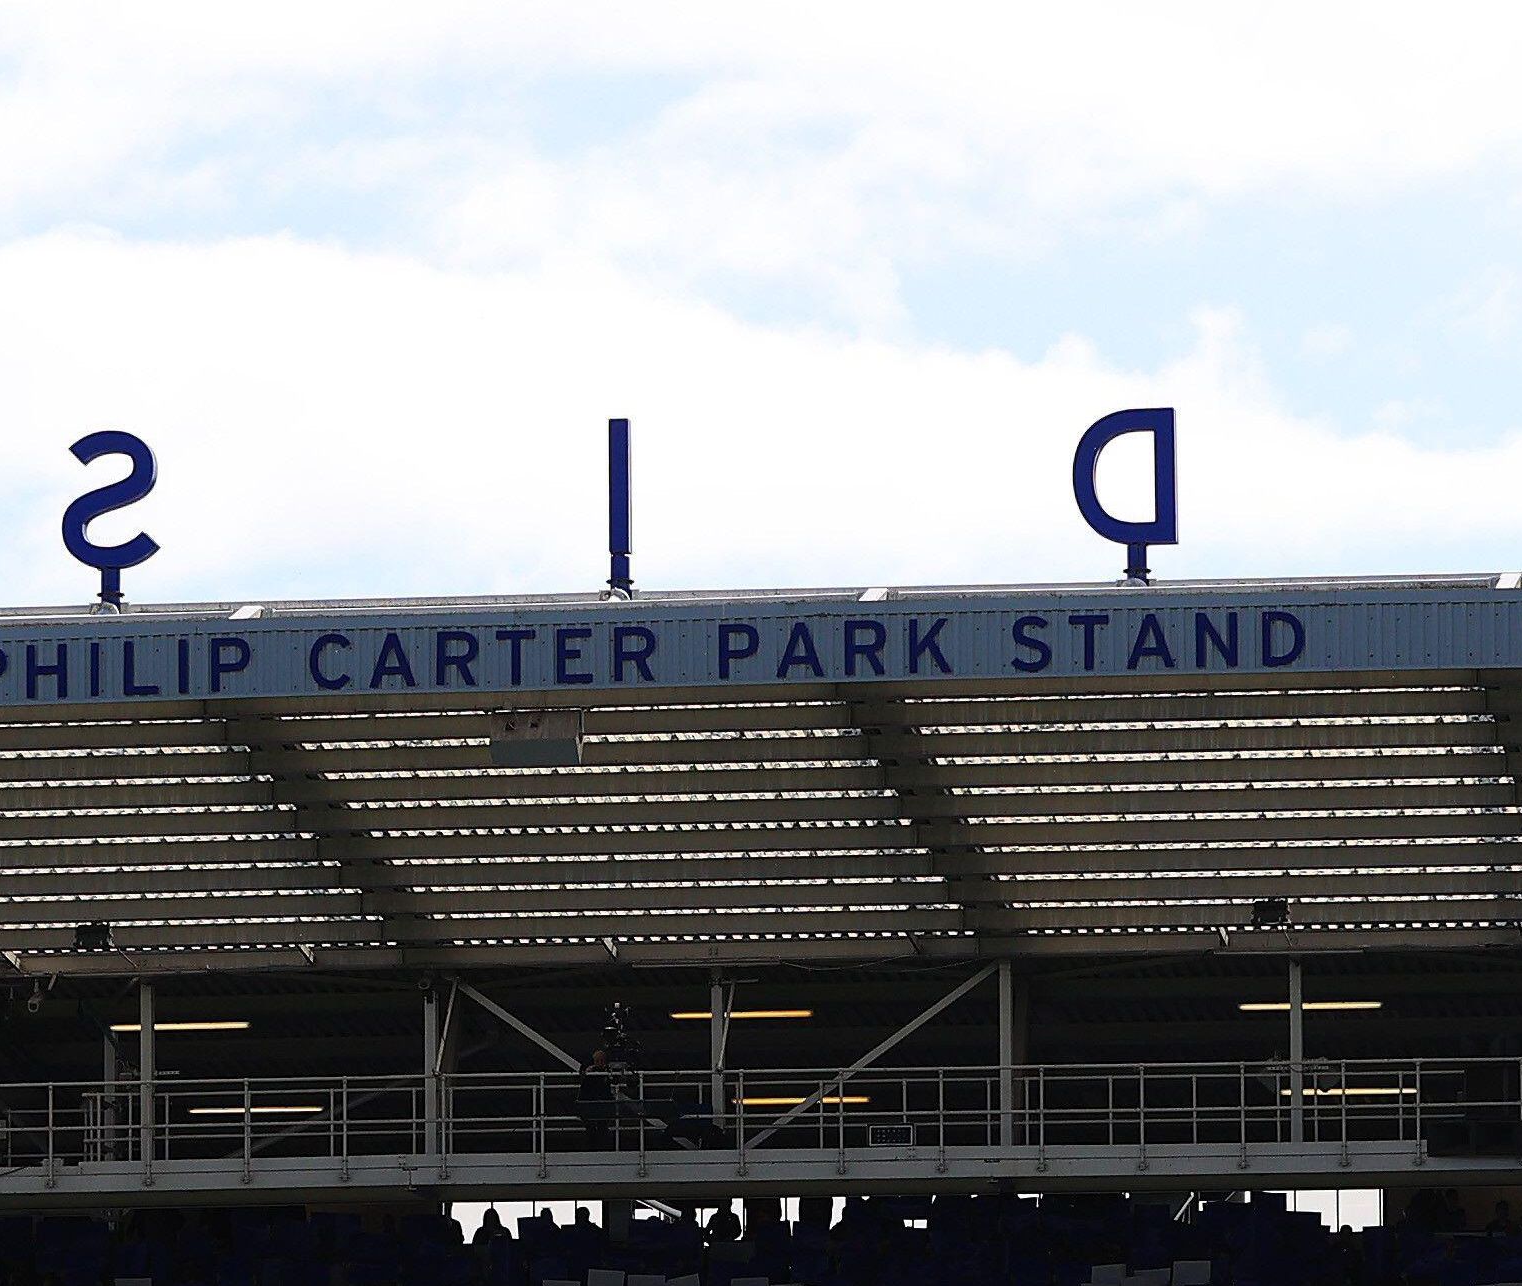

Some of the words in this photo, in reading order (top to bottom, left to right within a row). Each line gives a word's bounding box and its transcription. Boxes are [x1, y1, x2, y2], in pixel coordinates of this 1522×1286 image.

[309, 626, 656, 692] CARTER
[718, 617, 952, 680] PARK
[1011, 611, 1307, 674] STAND
